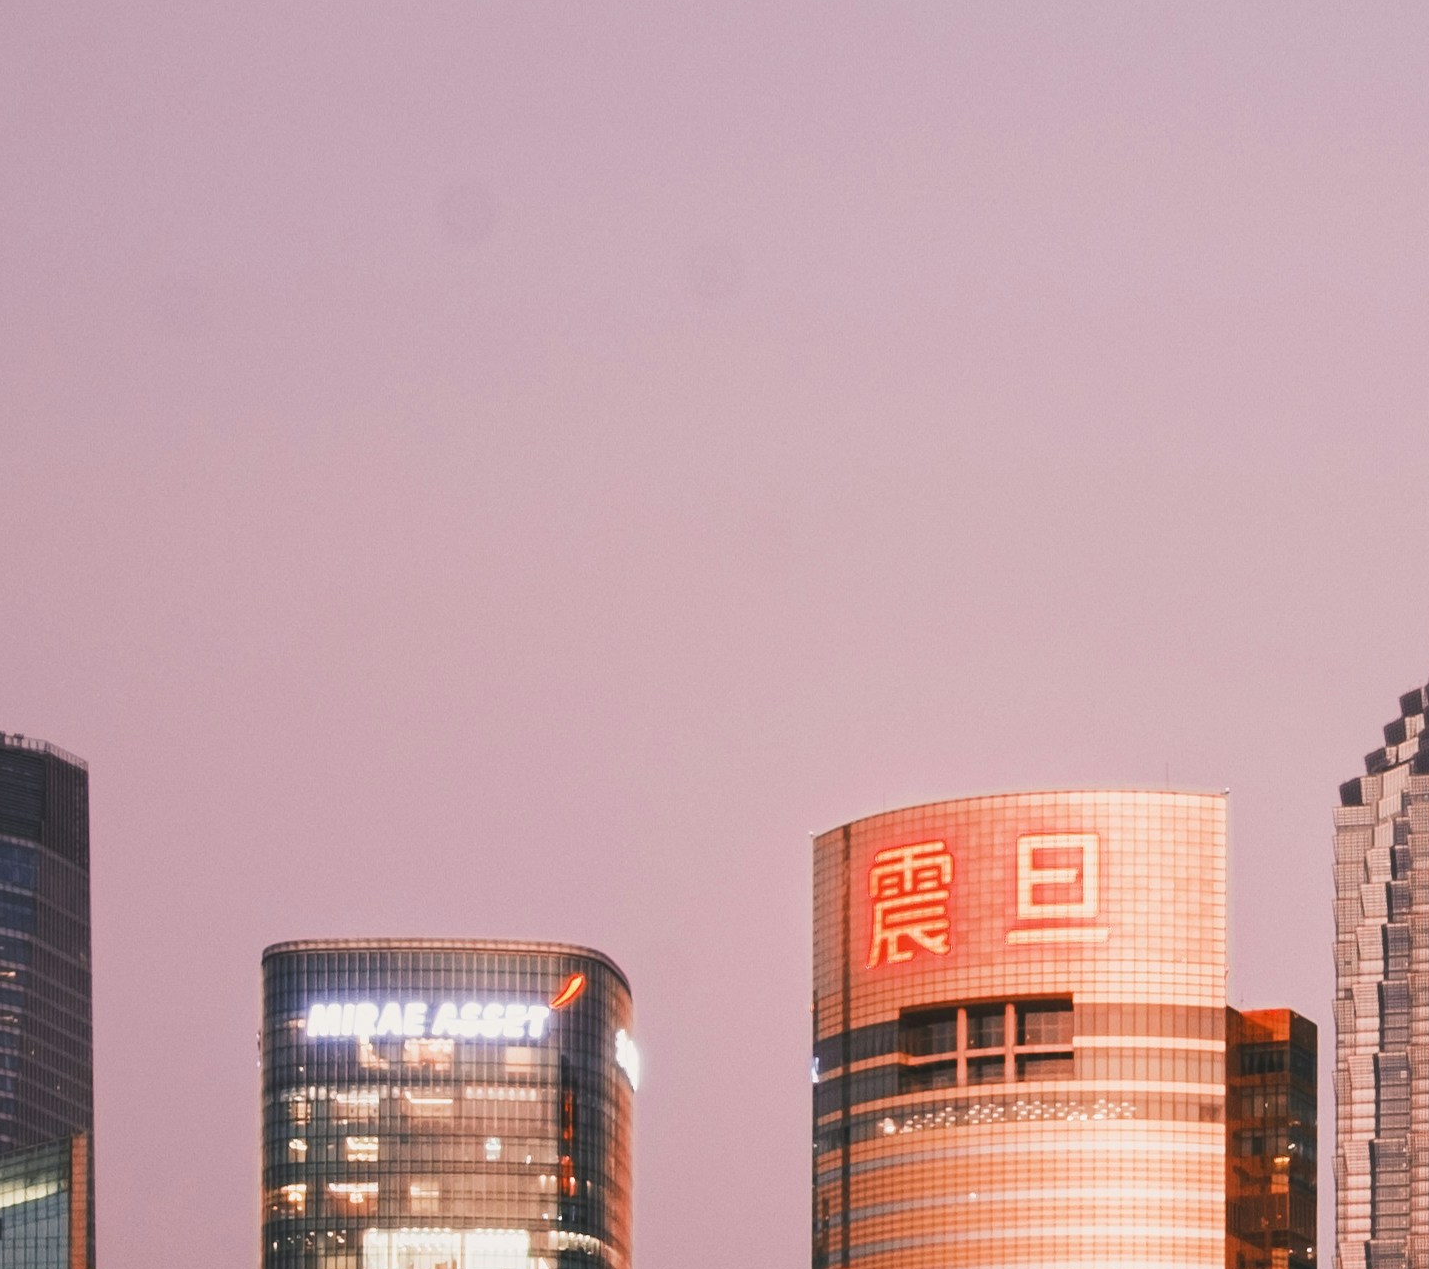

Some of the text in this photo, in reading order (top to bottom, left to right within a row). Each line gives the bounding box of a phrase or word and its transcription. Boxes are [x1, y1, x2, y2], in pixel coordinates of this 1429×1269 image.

[868, 834, 1110, 967] 震旦
[307, 1002, 549, 1038] MIRAE ASSET
